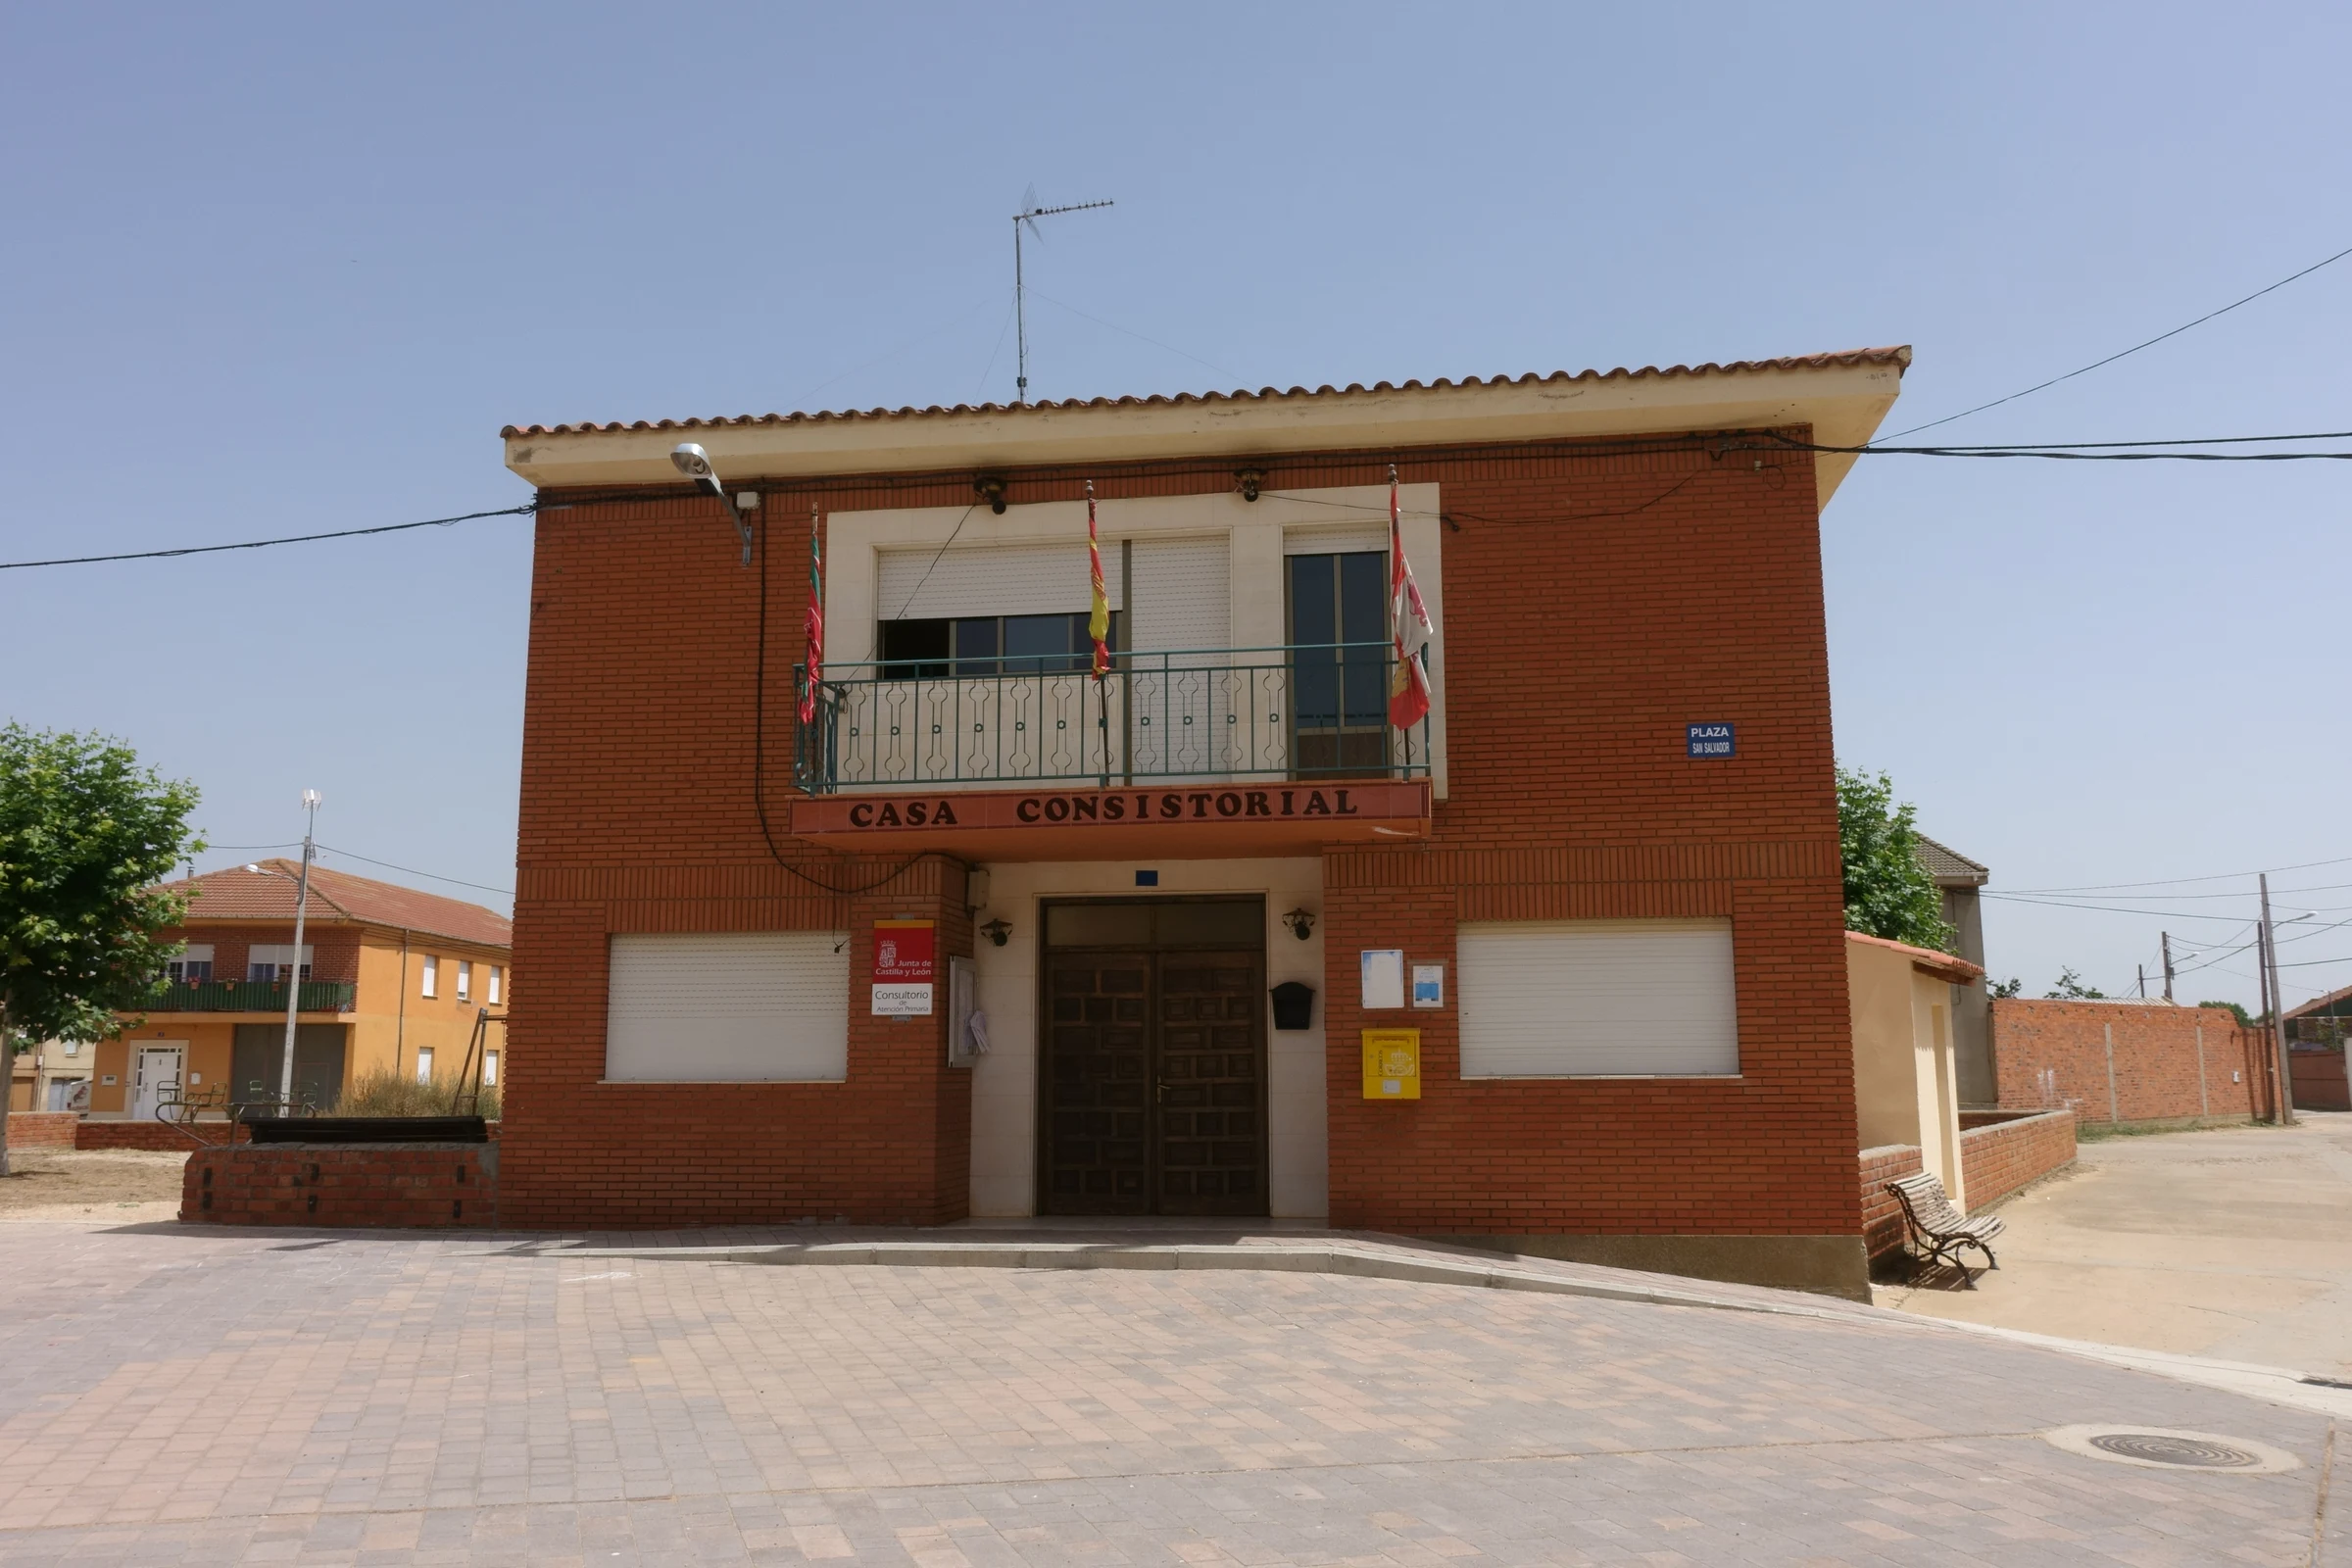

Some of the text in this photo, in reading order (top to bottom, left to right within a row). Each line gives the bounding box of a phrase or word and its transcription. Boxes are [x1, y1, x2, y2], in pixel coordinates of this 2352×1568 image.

[1690, 727, 1729, 737] PLAZA
[1692, 742, 1730, 754] SAN SALVADOR
[850, 789, 1358, 827] CASA CONSISTORIAL
[875, 990, 929, 1000] Consultorio
